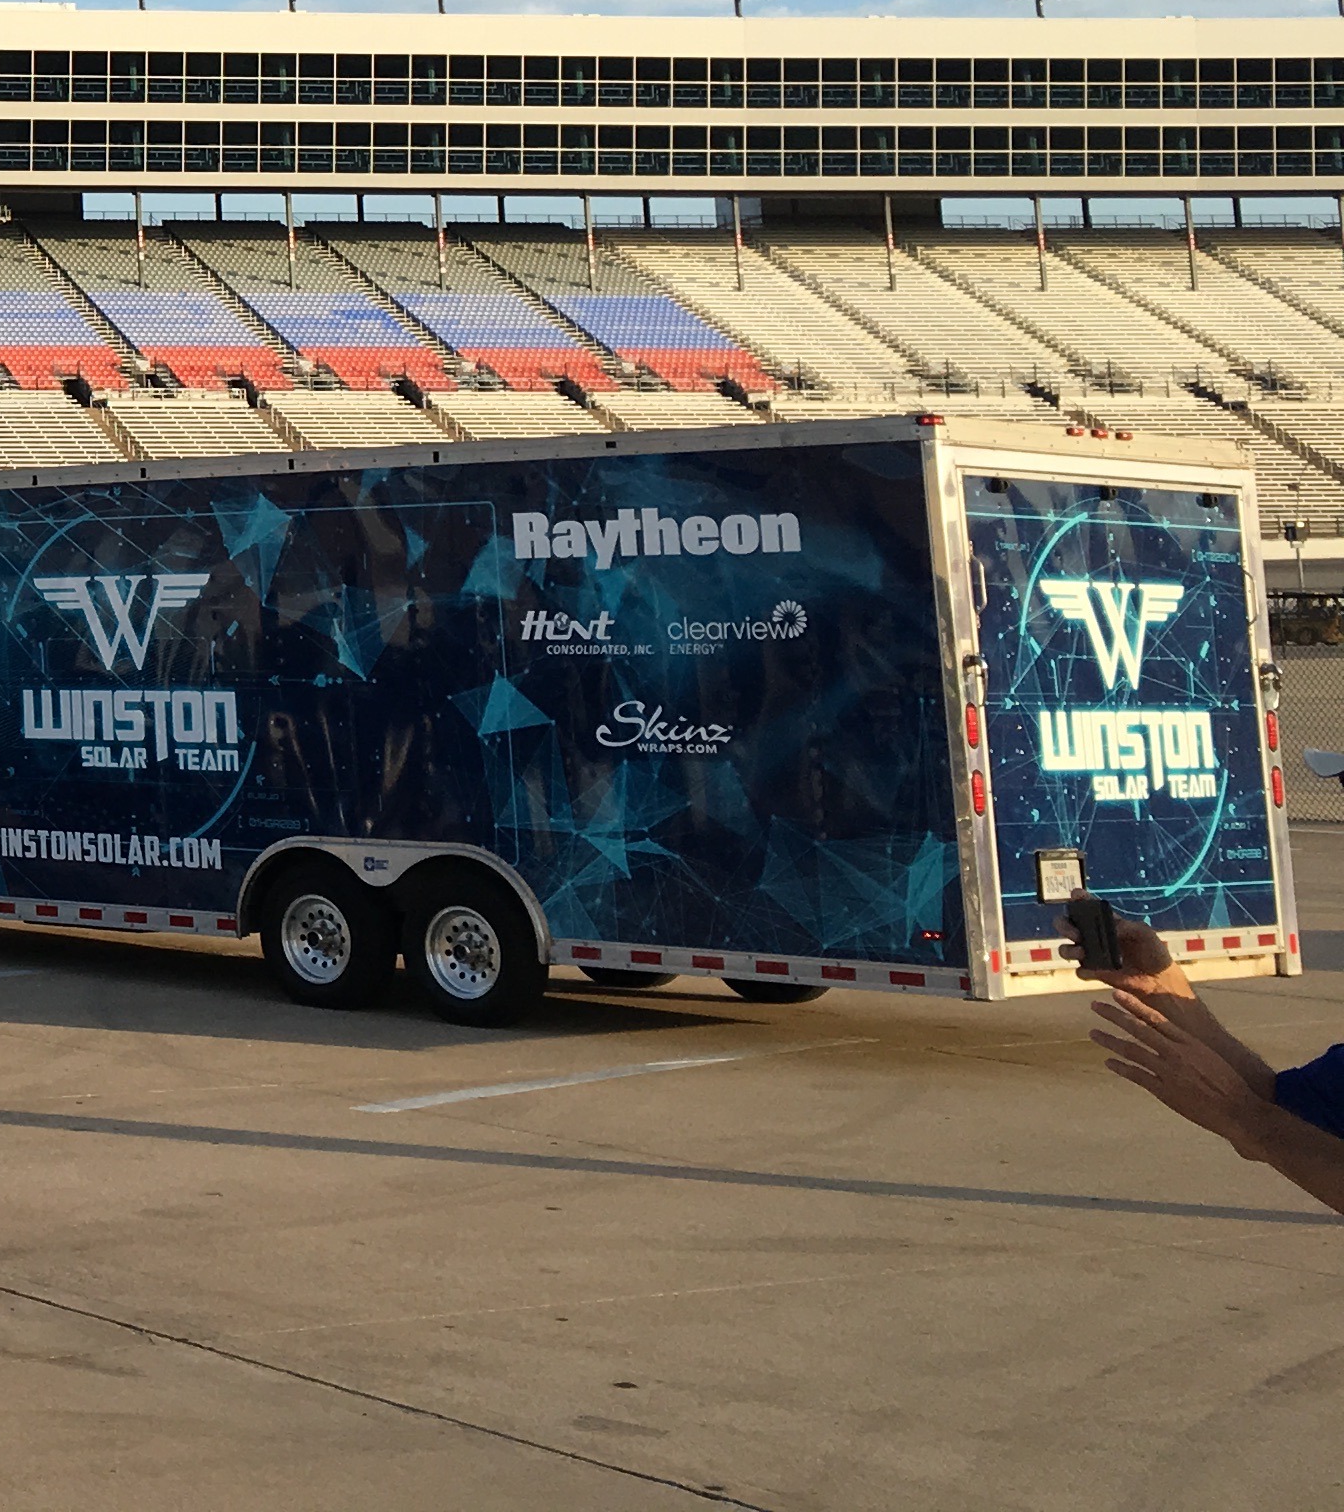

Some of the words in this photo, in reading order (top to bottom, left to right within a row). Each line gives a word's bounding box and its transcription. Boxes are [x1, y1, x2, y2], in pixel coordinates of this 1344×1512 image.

[512, 507, 802, 570] Raytheon
[667, 616, 790, 641] clearview
[546, 644, 631, 656] CONSOLIDATED,
[633, 644, 655, 656] INC.
[23, 689, 239, 762] WINSTON
[596, 699, 734, 748] Skinz
[81, 746, 147, 769] SOLAR
[175, 748, 240, 772] TEAM
[637, 742, 718, 754] WRAPS.COM
[1040, 710, 1217, 791] WINSTON
[1093, 774, 1150, 802] SOLAR
[1168, 774, 1217, 800] TEAM
